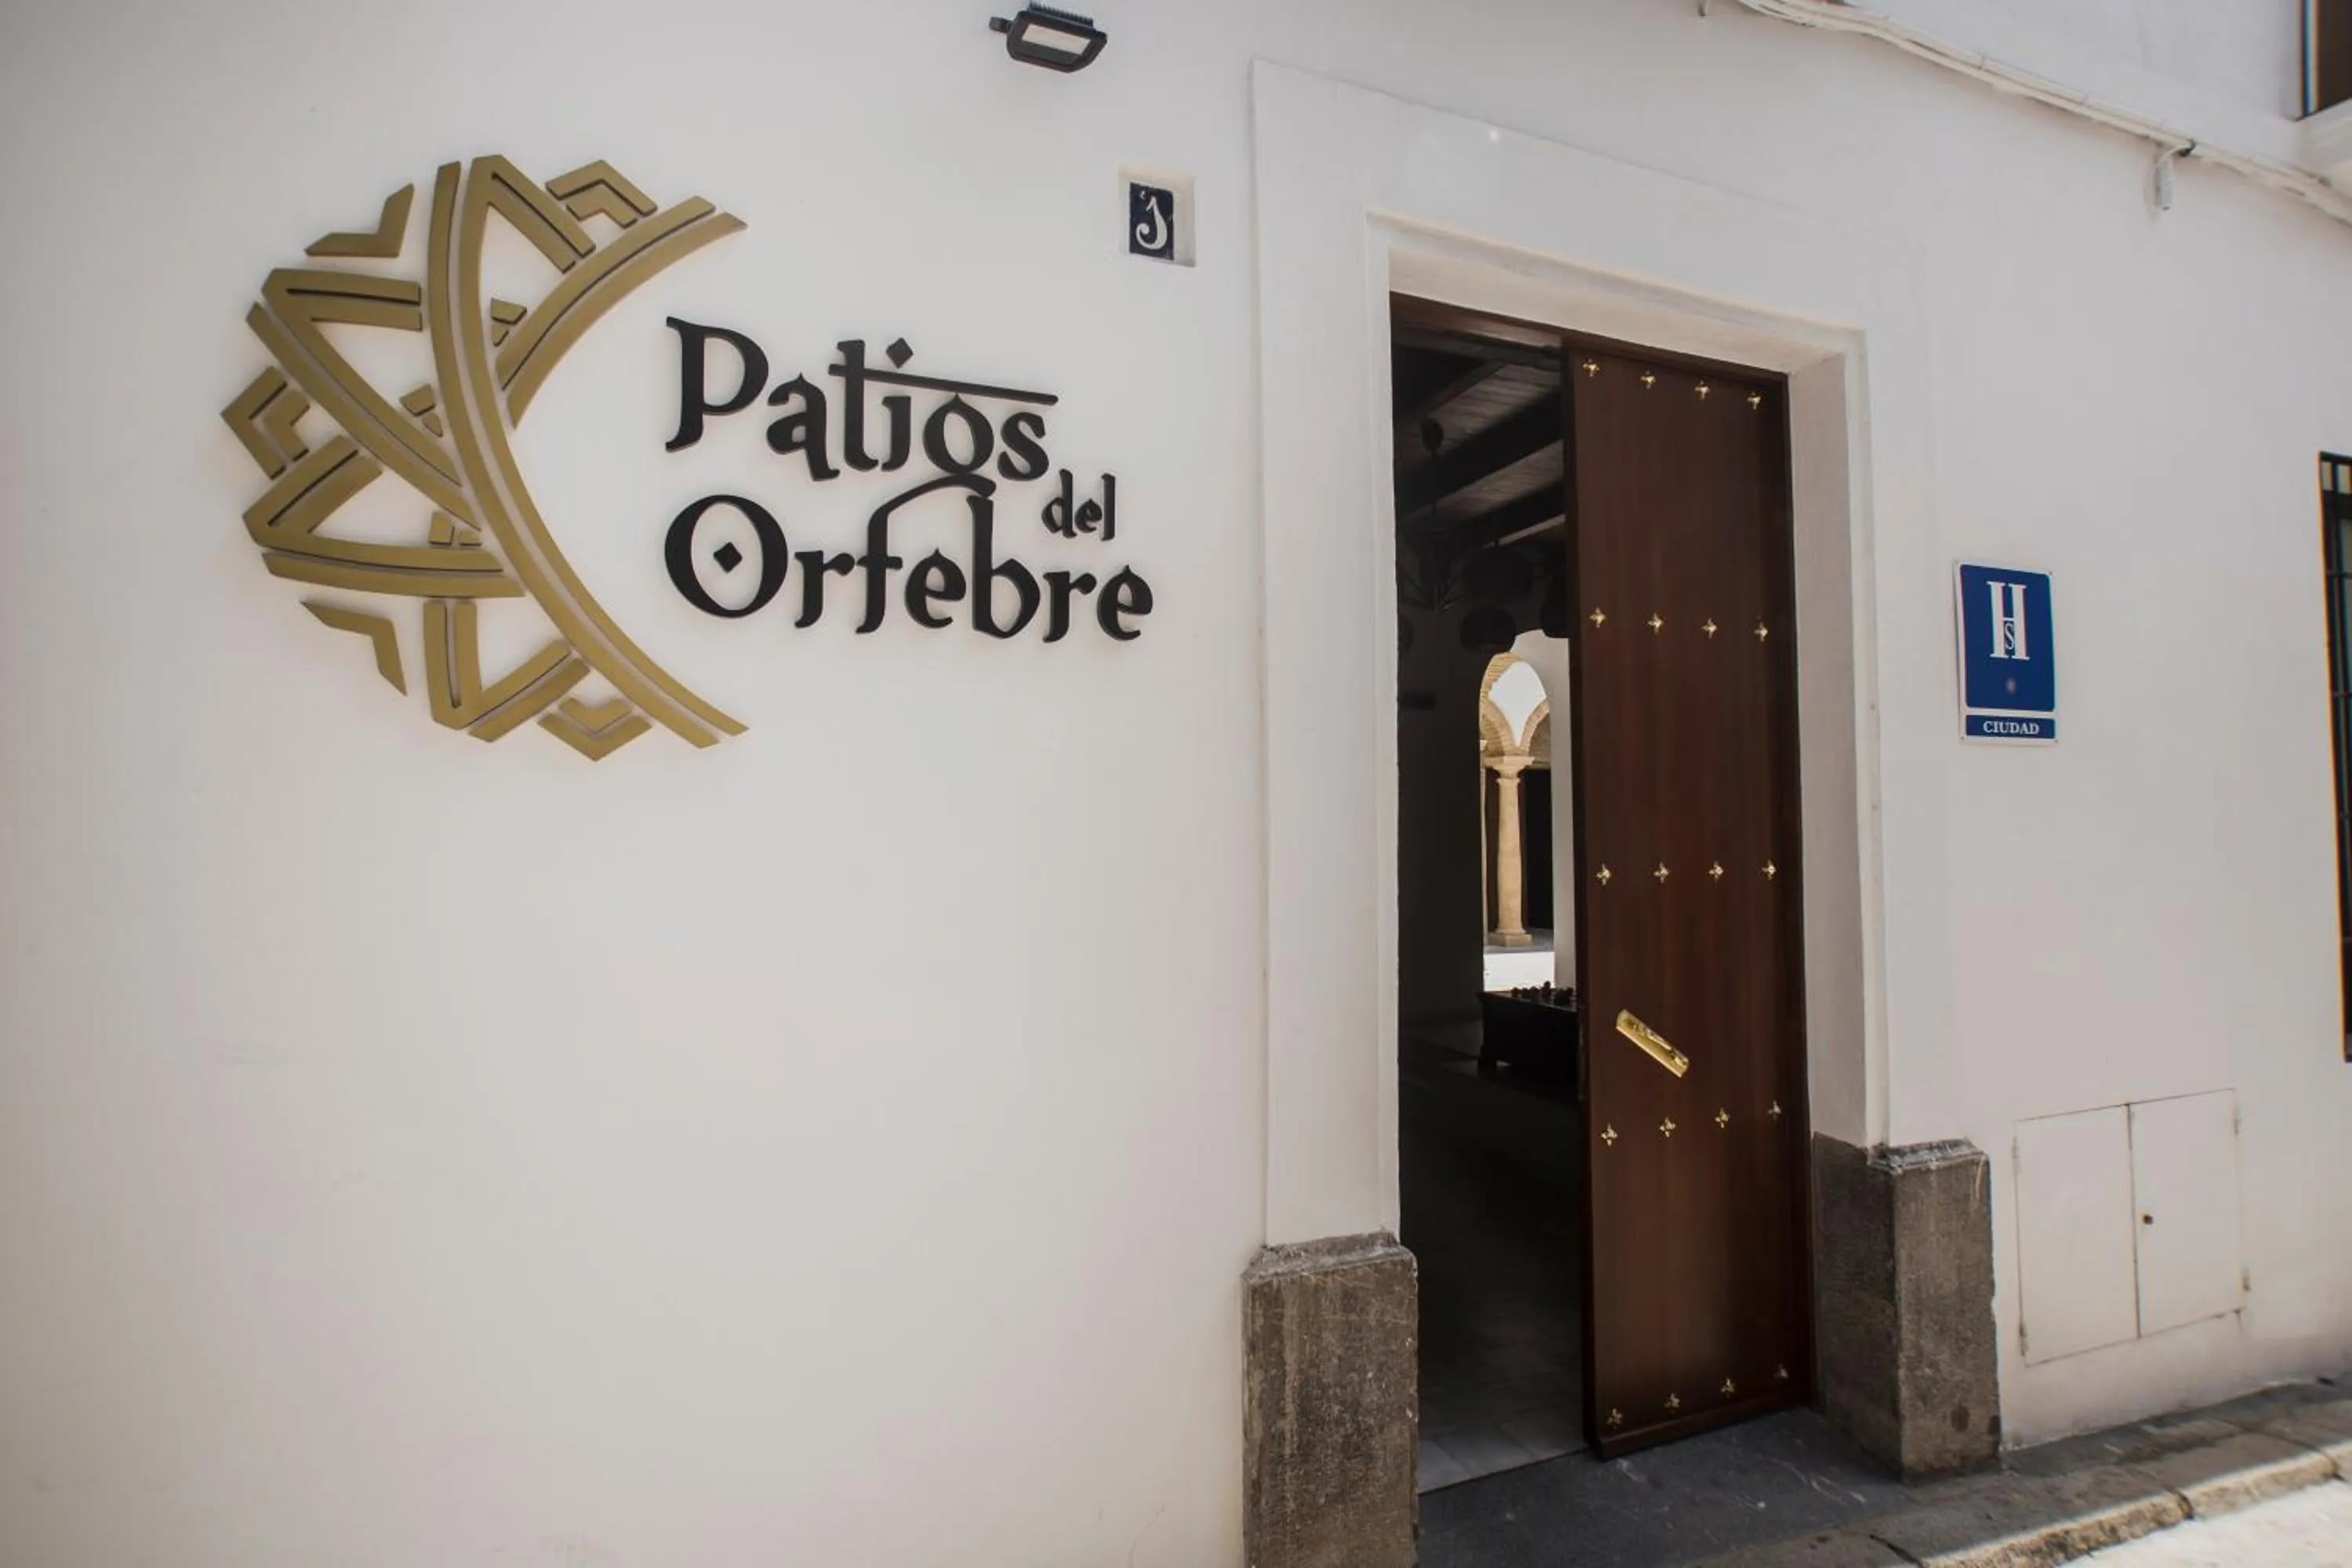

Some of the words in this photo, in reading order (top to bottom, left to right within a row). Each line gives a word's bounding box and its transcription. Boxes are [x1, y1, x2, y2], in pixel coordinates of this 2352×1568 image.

[664, 316, 1058, 483] Patios
[664, 472, 1154, 644] Orfebre
[1041, 468, 1116, 542] del
[1983, 720, 2039, 735] CIUDAD
